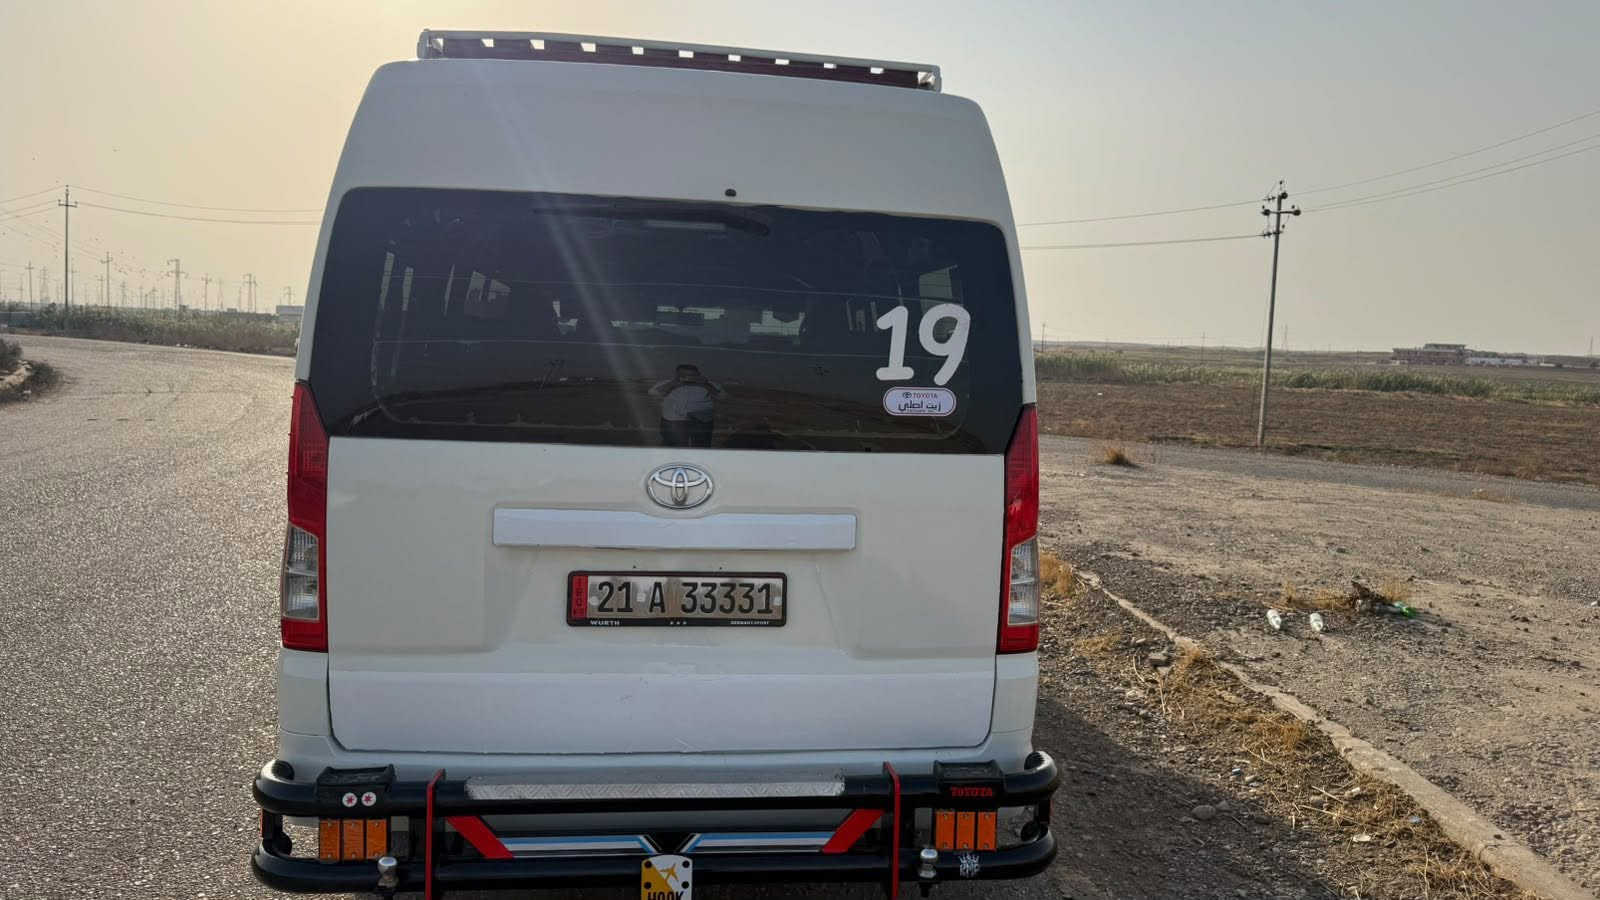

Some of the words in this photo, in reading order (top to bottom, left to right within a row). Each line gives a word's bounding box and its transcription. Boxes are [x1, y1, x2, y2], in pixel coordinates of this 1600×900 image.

[876, 303, 971, 386] 19
[597, 581, 633, 612] 21
[649, 581, 666, 613] A
[681, 582, 774, 614] 33331
[951, 786, 993, 797] TOYOTA
